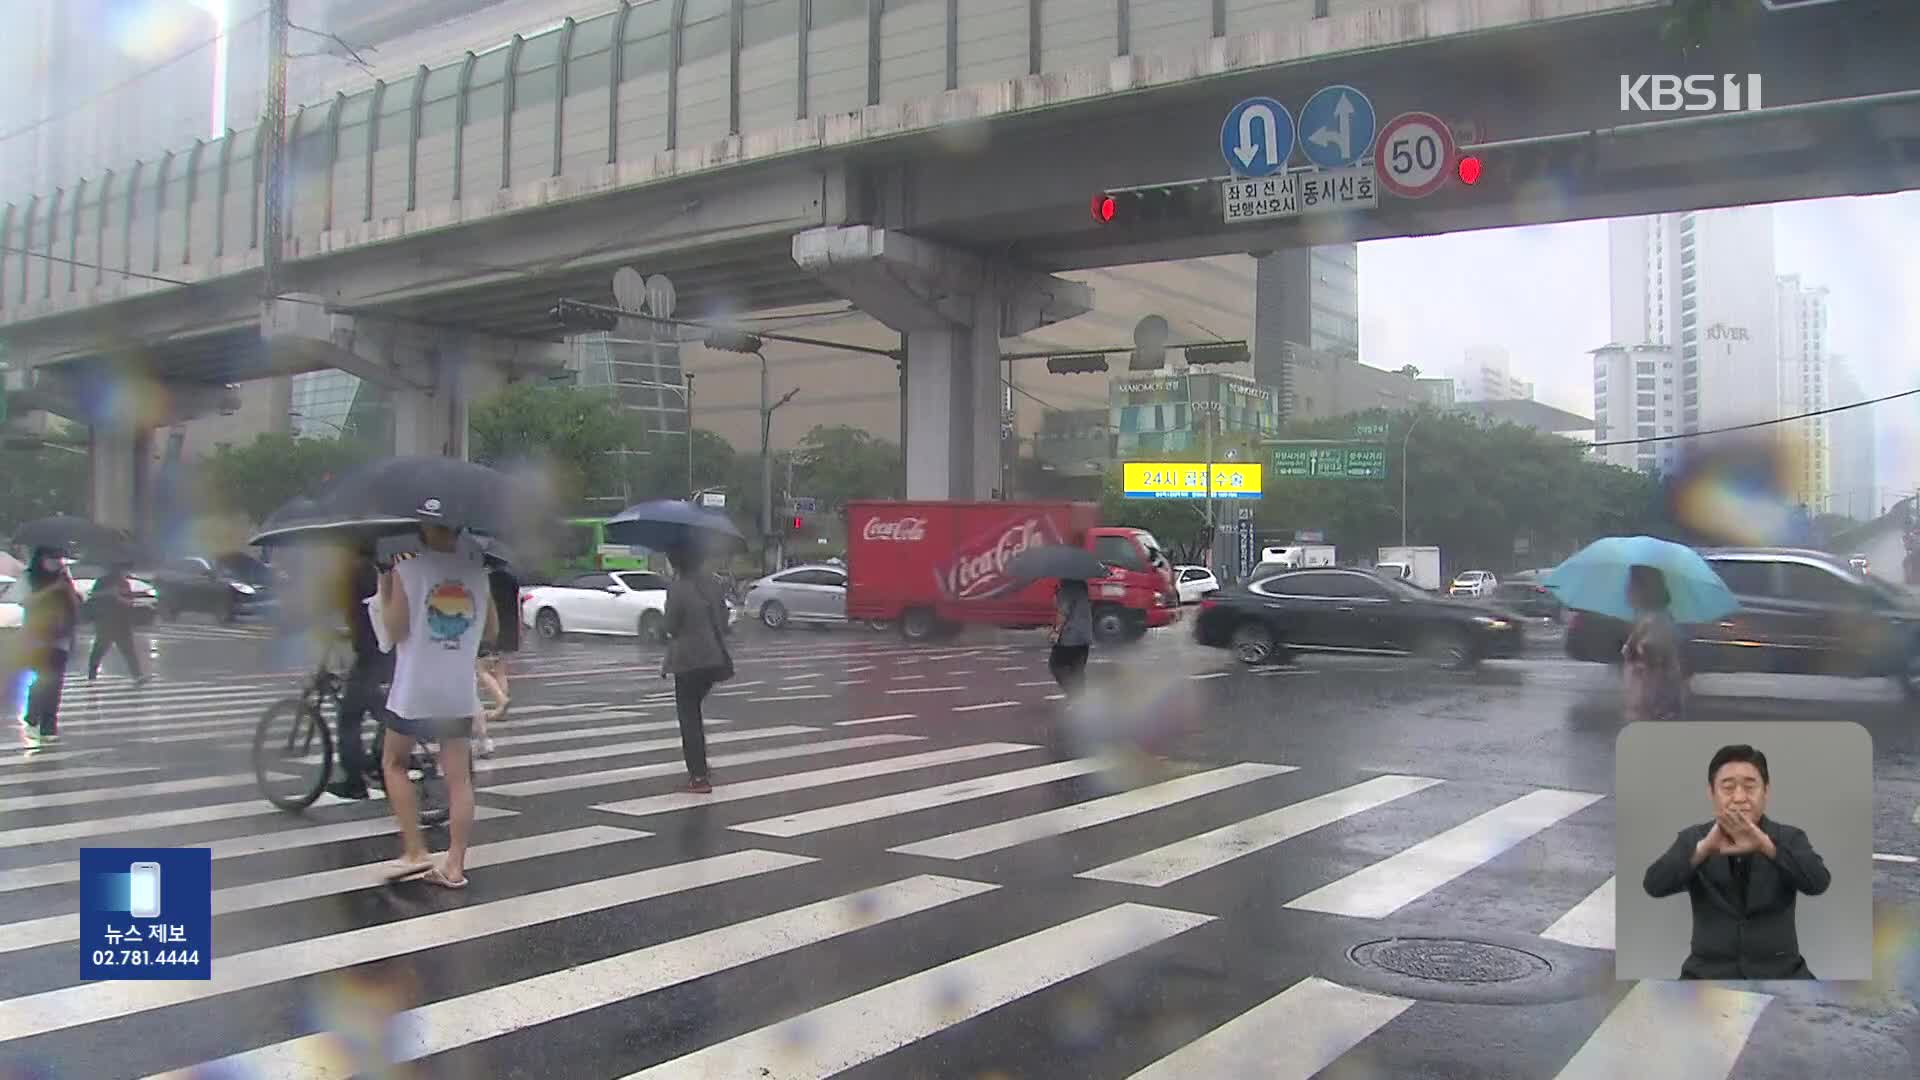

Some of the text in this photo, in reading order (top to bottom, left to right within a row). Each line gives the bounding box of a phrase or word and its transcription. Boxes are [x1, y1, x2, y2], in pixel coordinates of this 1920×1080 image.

[1391, 135, 1437, 175] 50
[1228, 179, 1294, 200] 좌회전시
[1303, 176, 1373, 206] 동시신호
[1706, 323, 1749, 341] RIVER
[1143, 471, 1176, 486] 24시
[1215, 471, 1242, 487] 수술
